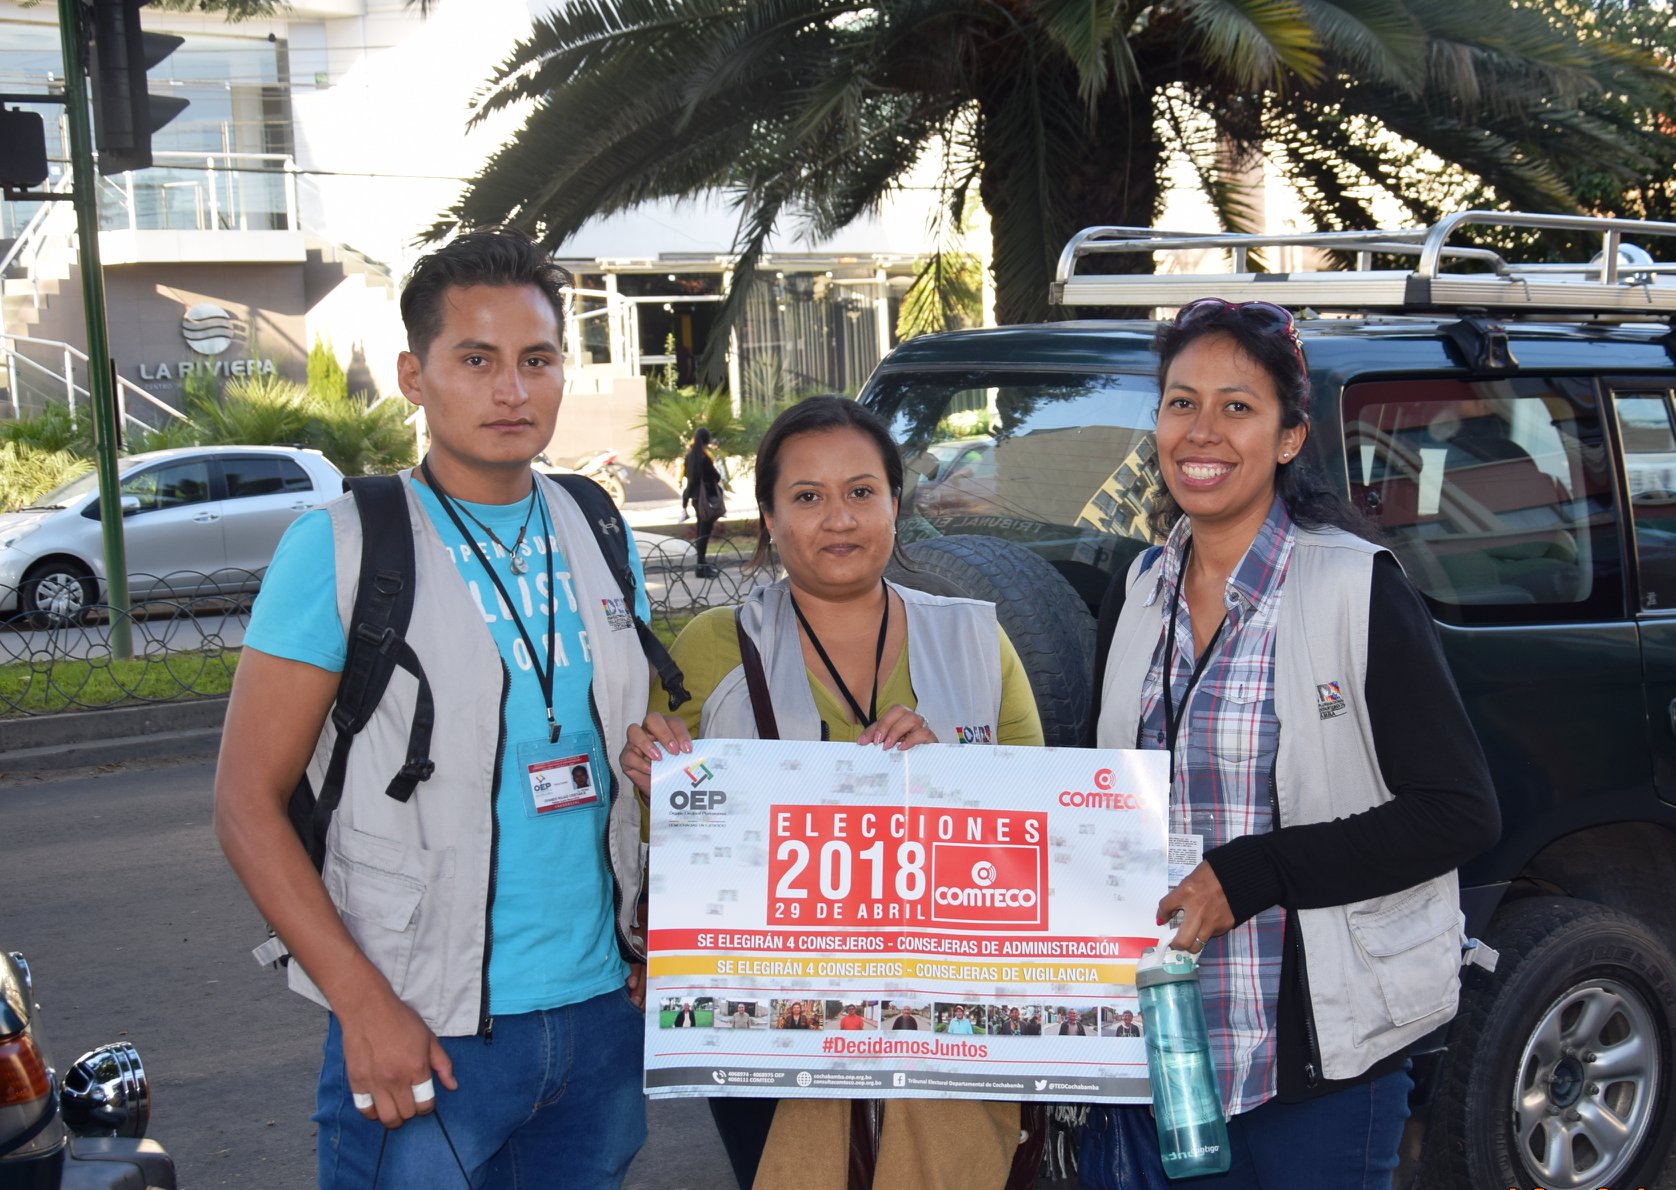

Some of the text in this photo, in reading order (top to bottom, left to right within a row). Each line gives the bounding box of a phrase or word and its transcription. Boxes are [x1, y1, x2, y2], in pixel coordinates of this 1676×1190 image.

[139, 359, 277, 380] LA RIVIERA
[534, 782, 552, 792] OEP
[669, 790, 727, 810] OEP
[777, 813, 1040, 843] ELECCIONES
[775, 840, 926, 900] 2018
[935, 886, 1036, 908] COMTECO
[775, 903, 925, 920] 29 DE ABRIL
[697, 934, 714, 947] SE
[718, 933, 783, 949] ELEGIRÁN
[786, 936, 795, 949] 4
[798, 936, 884, 950] CONSEJEROS
[897, 936, 978, 954] CONSEJERAS
[981, 941, 999, 955] DE
[1002, 939, 1119, 956] ADMINISTRACIÓN
[717, 960, 734, 974] SE
[738, 959, 803, 975] ELEGIRÁN
[806, 962, 814, 976] 4
[818, 962, 903, 976] CONSEJEROS
[915, 963, 997, 980] CONSEJERAS
[1002, 967, 1019, 981] DE
[1022, 967, 1099, 982] VIGILANCIA
[822, 1037, 988, 1058] #DecidamosJuntos
[949, 1080, 985, 1088] Departamental
[1048, 1083, 1100, 1091] @TEDCochabamba
